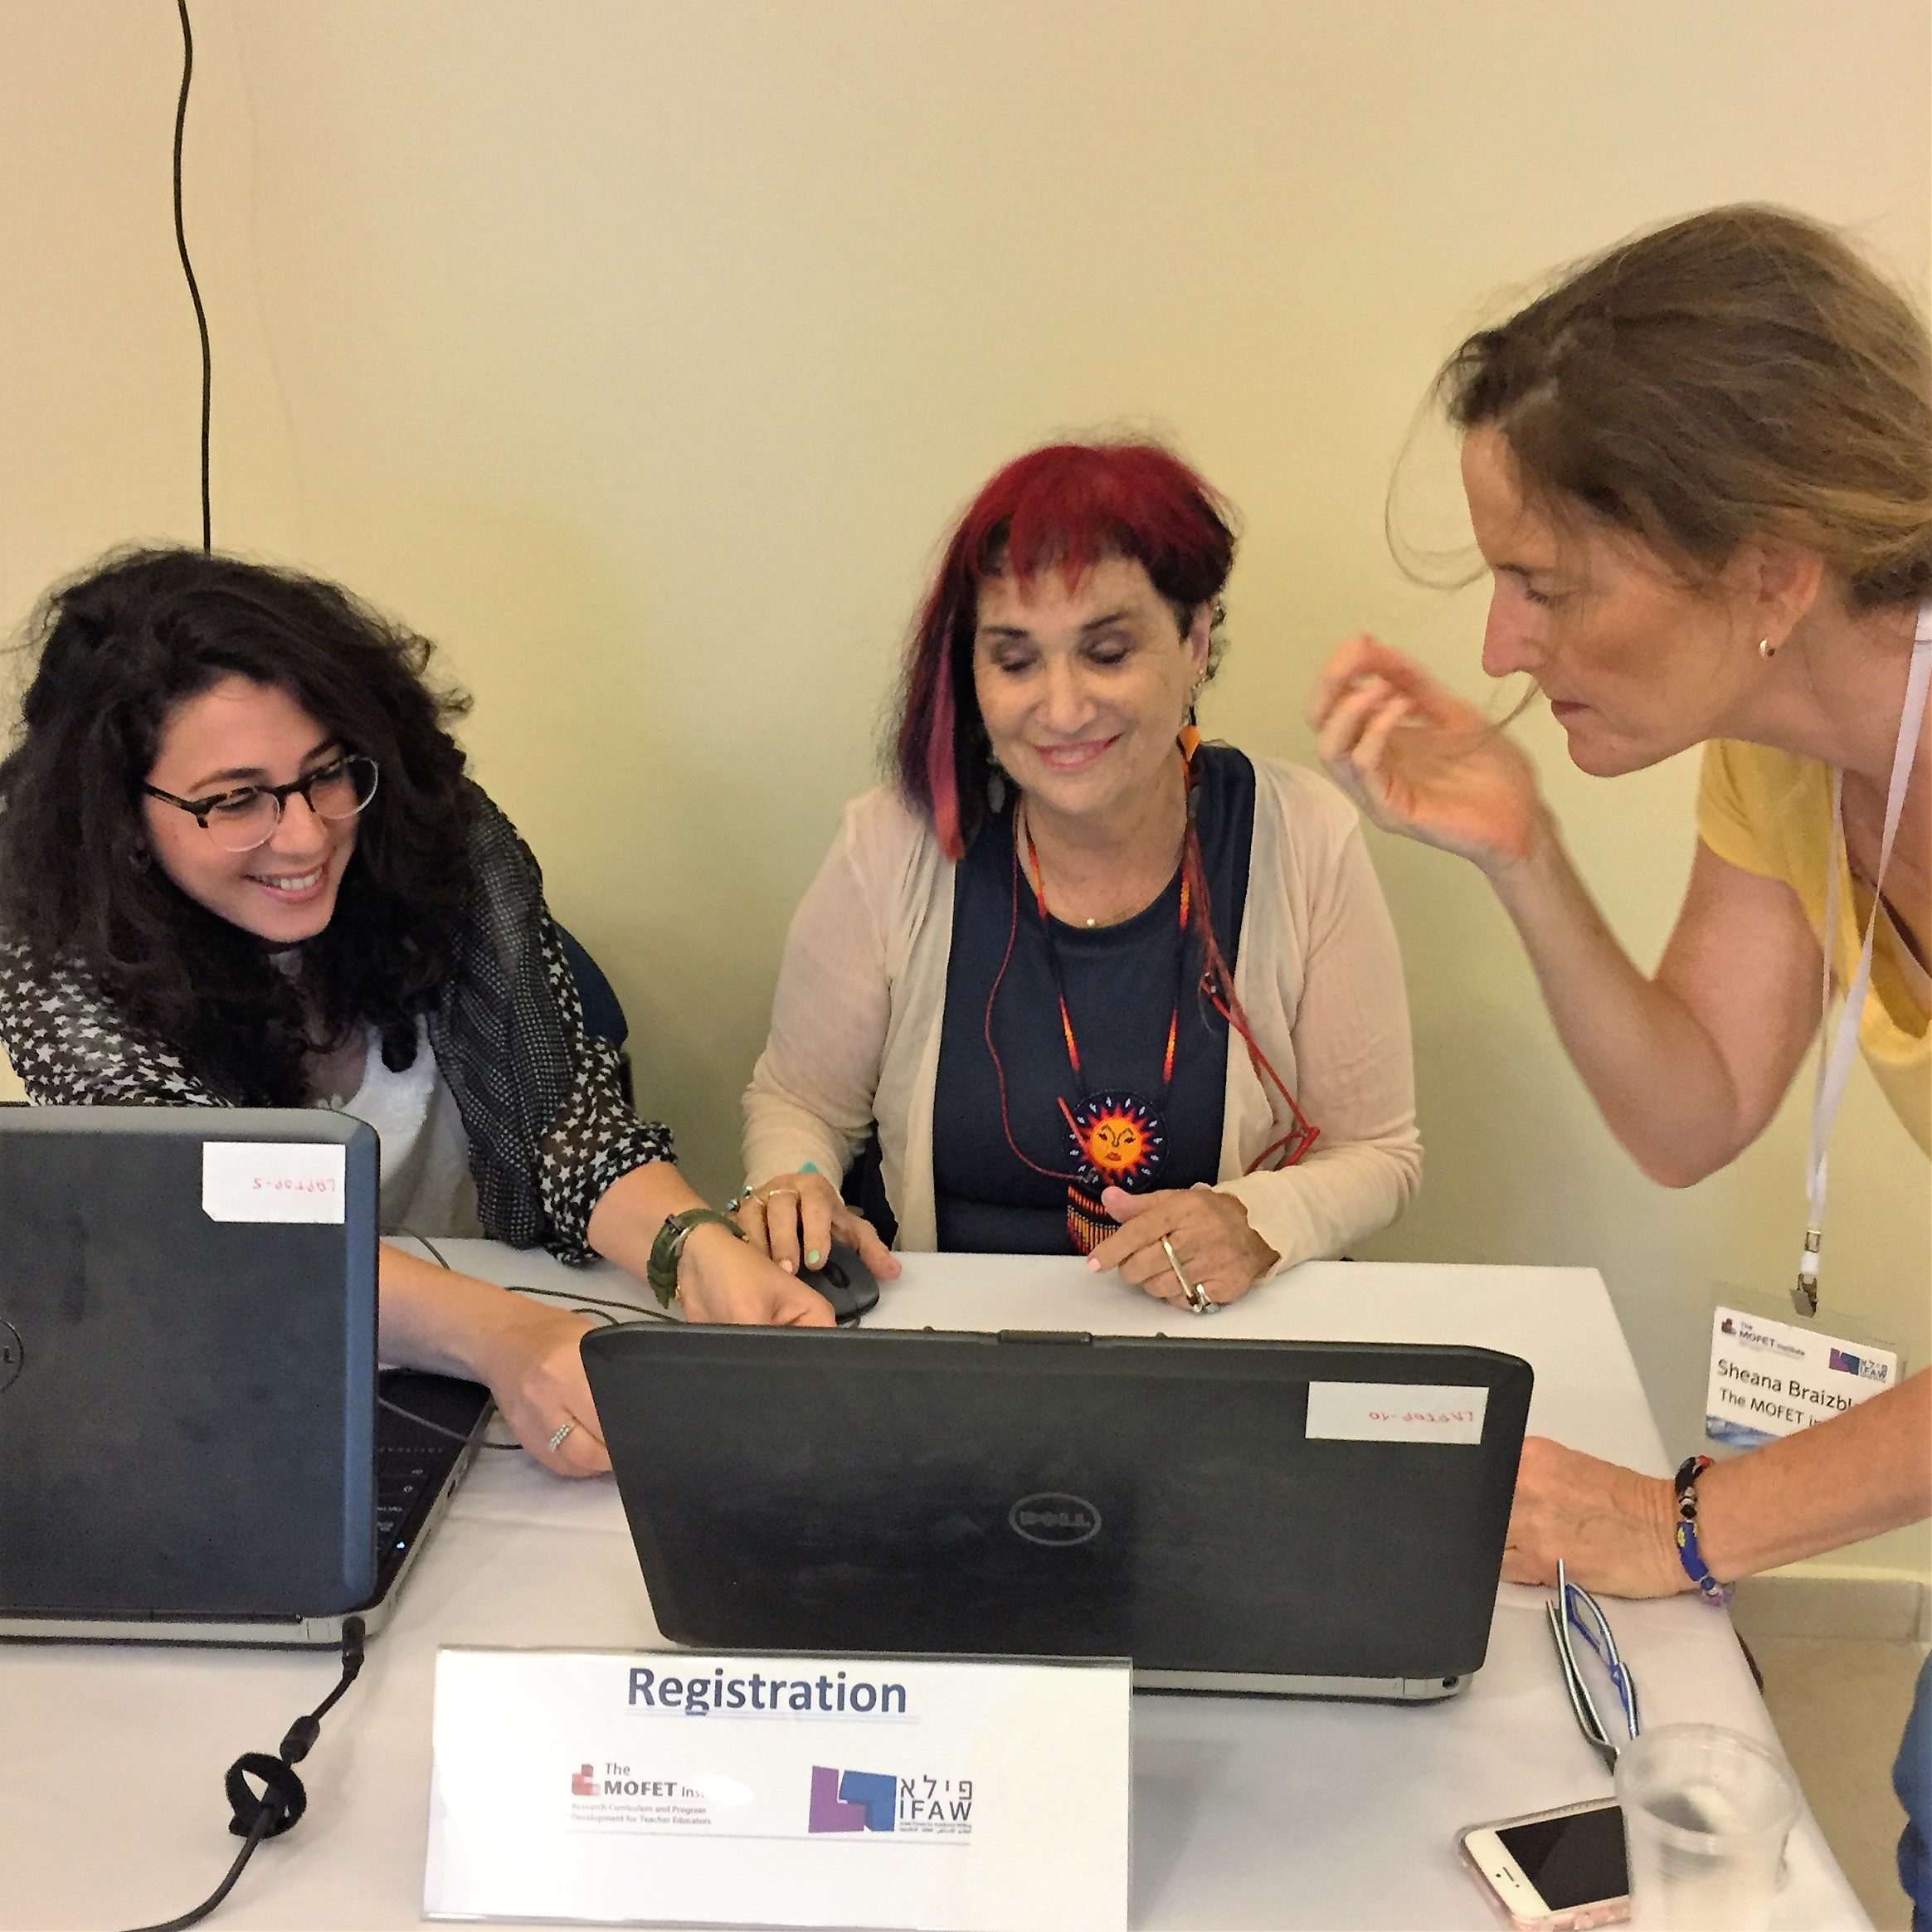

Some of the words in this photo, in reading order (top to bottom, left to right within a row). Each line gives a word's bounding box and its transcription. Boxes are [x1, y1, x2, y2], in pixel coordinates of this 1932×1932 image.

[1740, 1330, 1774, 1347] MOFET
[1717, 1358, 1782, 1392] Sheana
[1860, 1365, 1887, 1378] IFAW
[1720, 1387, 1745, 1407] The
[1750, 1398, 1804, 1424] MOFET
[1020, 1511, 1091, 1527] DELL
[628, 1667, 907, 1715] Registration
[605, 1762, 630, 1776] The
[604, 1780, 677, 1797] MOFET
[901, 1774, 972, 1800] פילא
[673, 1805, 706, 1815] Program
[900, 1800, 971, 1821] IFAW
[572, 1813, 624, 1823] Development
[626, 1814, 637, 1823] for
[640, 1816, 670, 1824] Teacher
[673, 1816, 711, 1825] Educators
